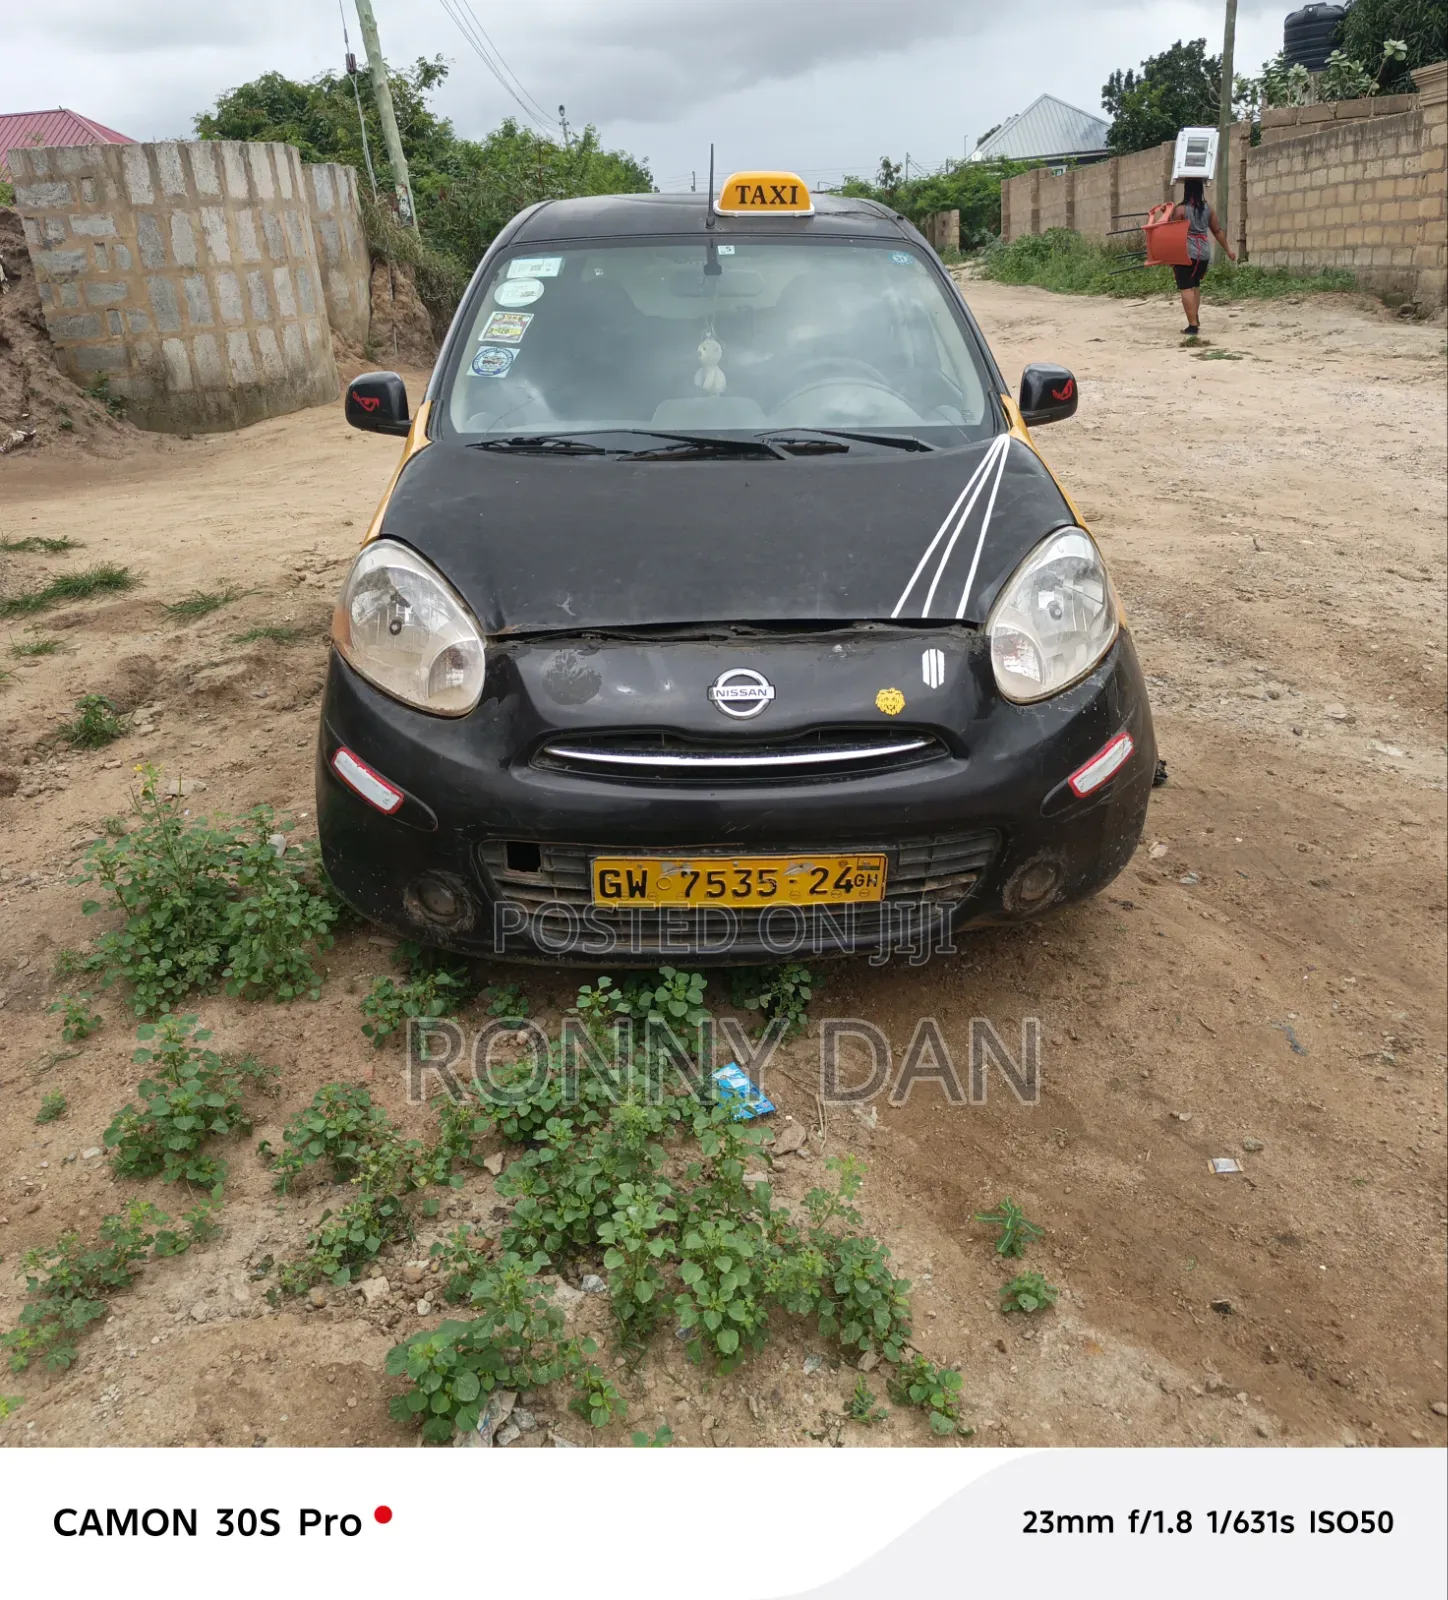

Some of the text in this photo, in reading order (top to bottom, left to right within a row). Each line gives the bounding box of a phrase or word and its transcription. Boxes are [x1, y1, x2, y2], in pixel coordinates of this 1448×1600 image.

[736, 185, 799, 205] TAXI
[716, 689, 767, 697] NISSAN
[599, 869, 648, 898] GW
[854, 873, 878, 887] GH
